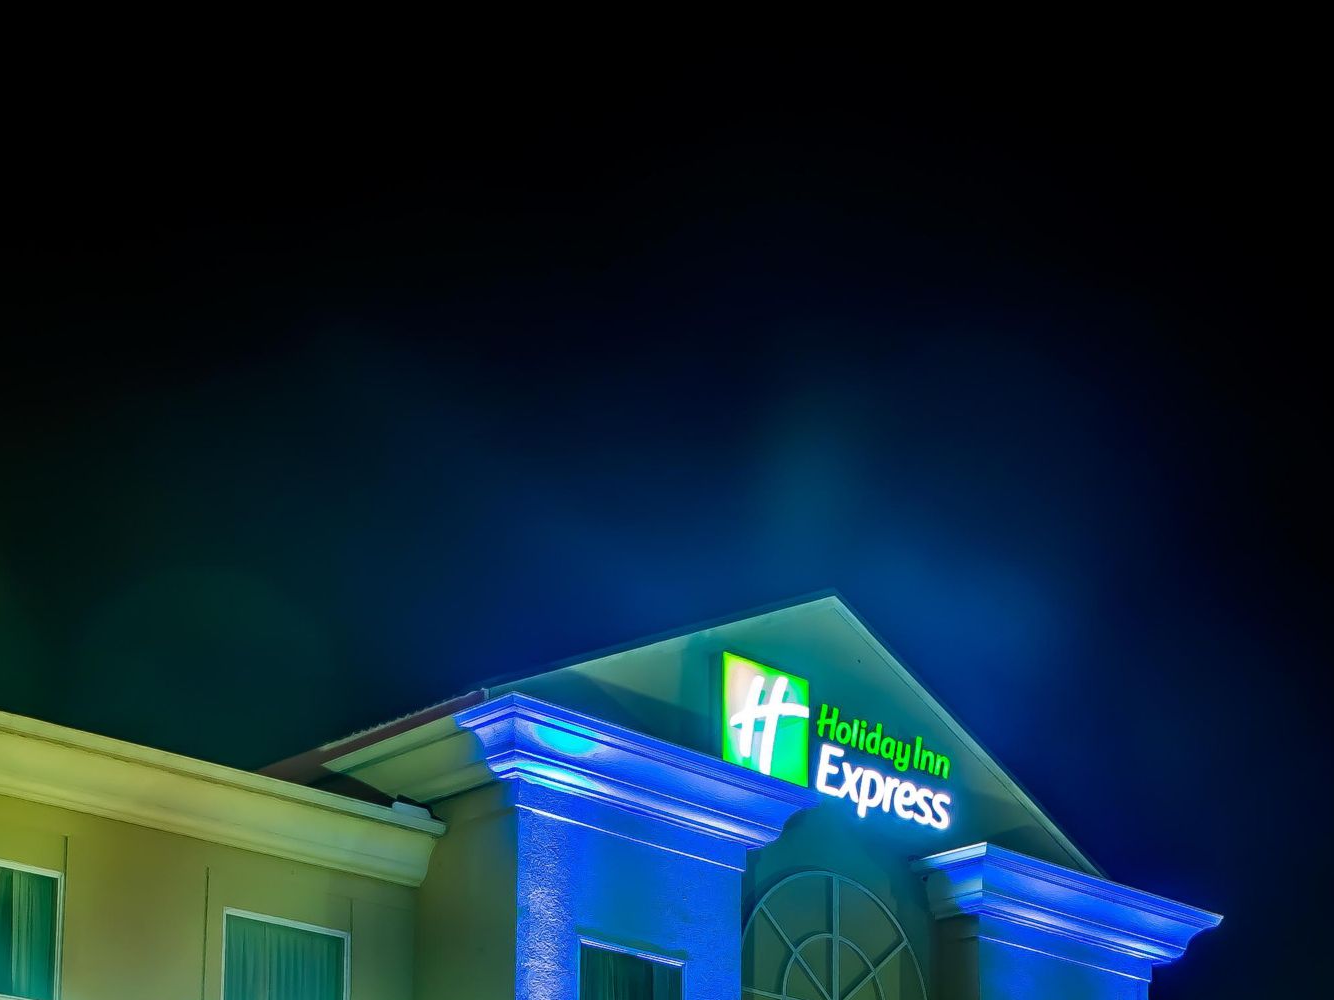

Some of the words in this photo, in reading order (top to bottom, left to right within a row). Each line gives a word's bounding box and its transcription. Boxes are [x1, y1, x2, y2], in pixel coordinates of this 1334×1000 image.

[817, 703, 911, 772] Holiday
[913, 736, 951, 779] Inn
[816, 744, 952, 831] Express
